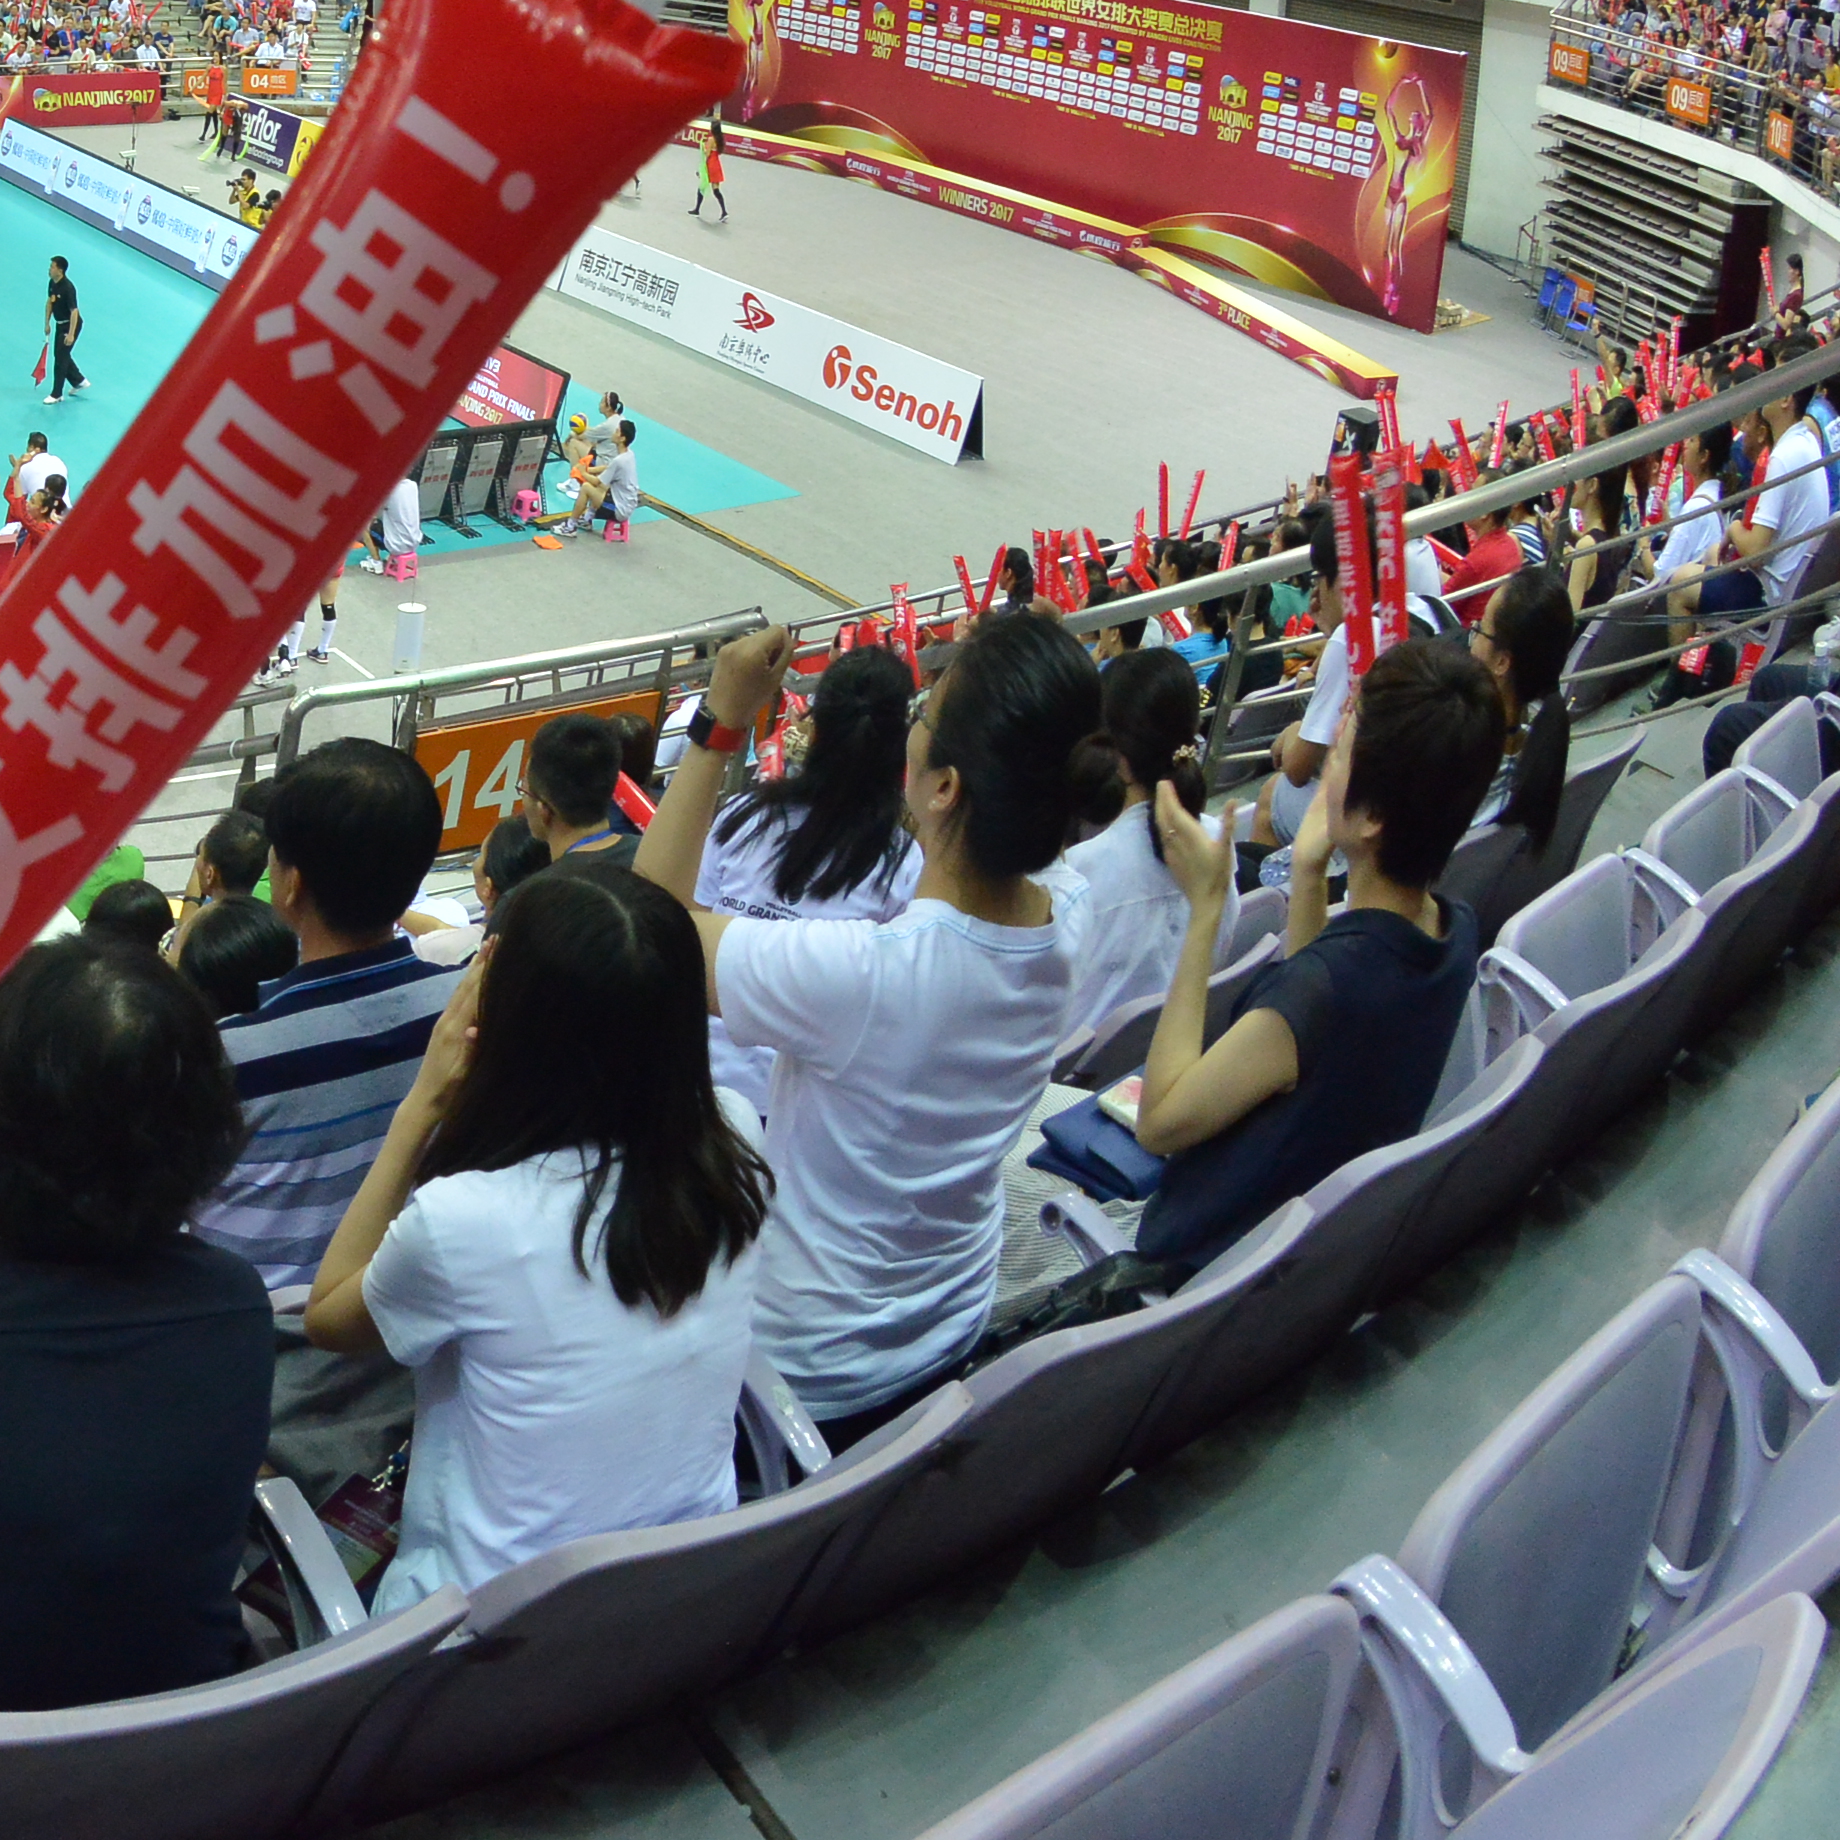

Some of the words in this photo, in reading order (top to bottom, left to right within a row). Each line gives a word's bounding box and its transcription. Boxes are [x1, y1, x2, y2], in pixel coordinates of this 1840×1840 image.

[864, 29, 901, 48] NANJING
[872, 45, 891, 60] 2017
[1553, 50, 1567, 72] 09
[251, 75, 268, 88] 04
[63, 90, 123, 109] NANJING
[125, 89, 155, 104] 2017
[1207, 106, 1254, 130] NANJING
[1217, 125, 1242, 144] 2017
[939, 185, 987, 215] WINNERS
[990, 202, 1014, 223] 2017
[579, 249, 679, 306] 南京江宁高新园
[574, 274, 596, 290] Nanjing
[597, 282, 625, 301] Jiangning
[626, 294, 656, 312] High-tech
[656, 305, 671, 319] Park
[851, 365, 962, 442] Senoh
[432, 737, 522, 832] 14
